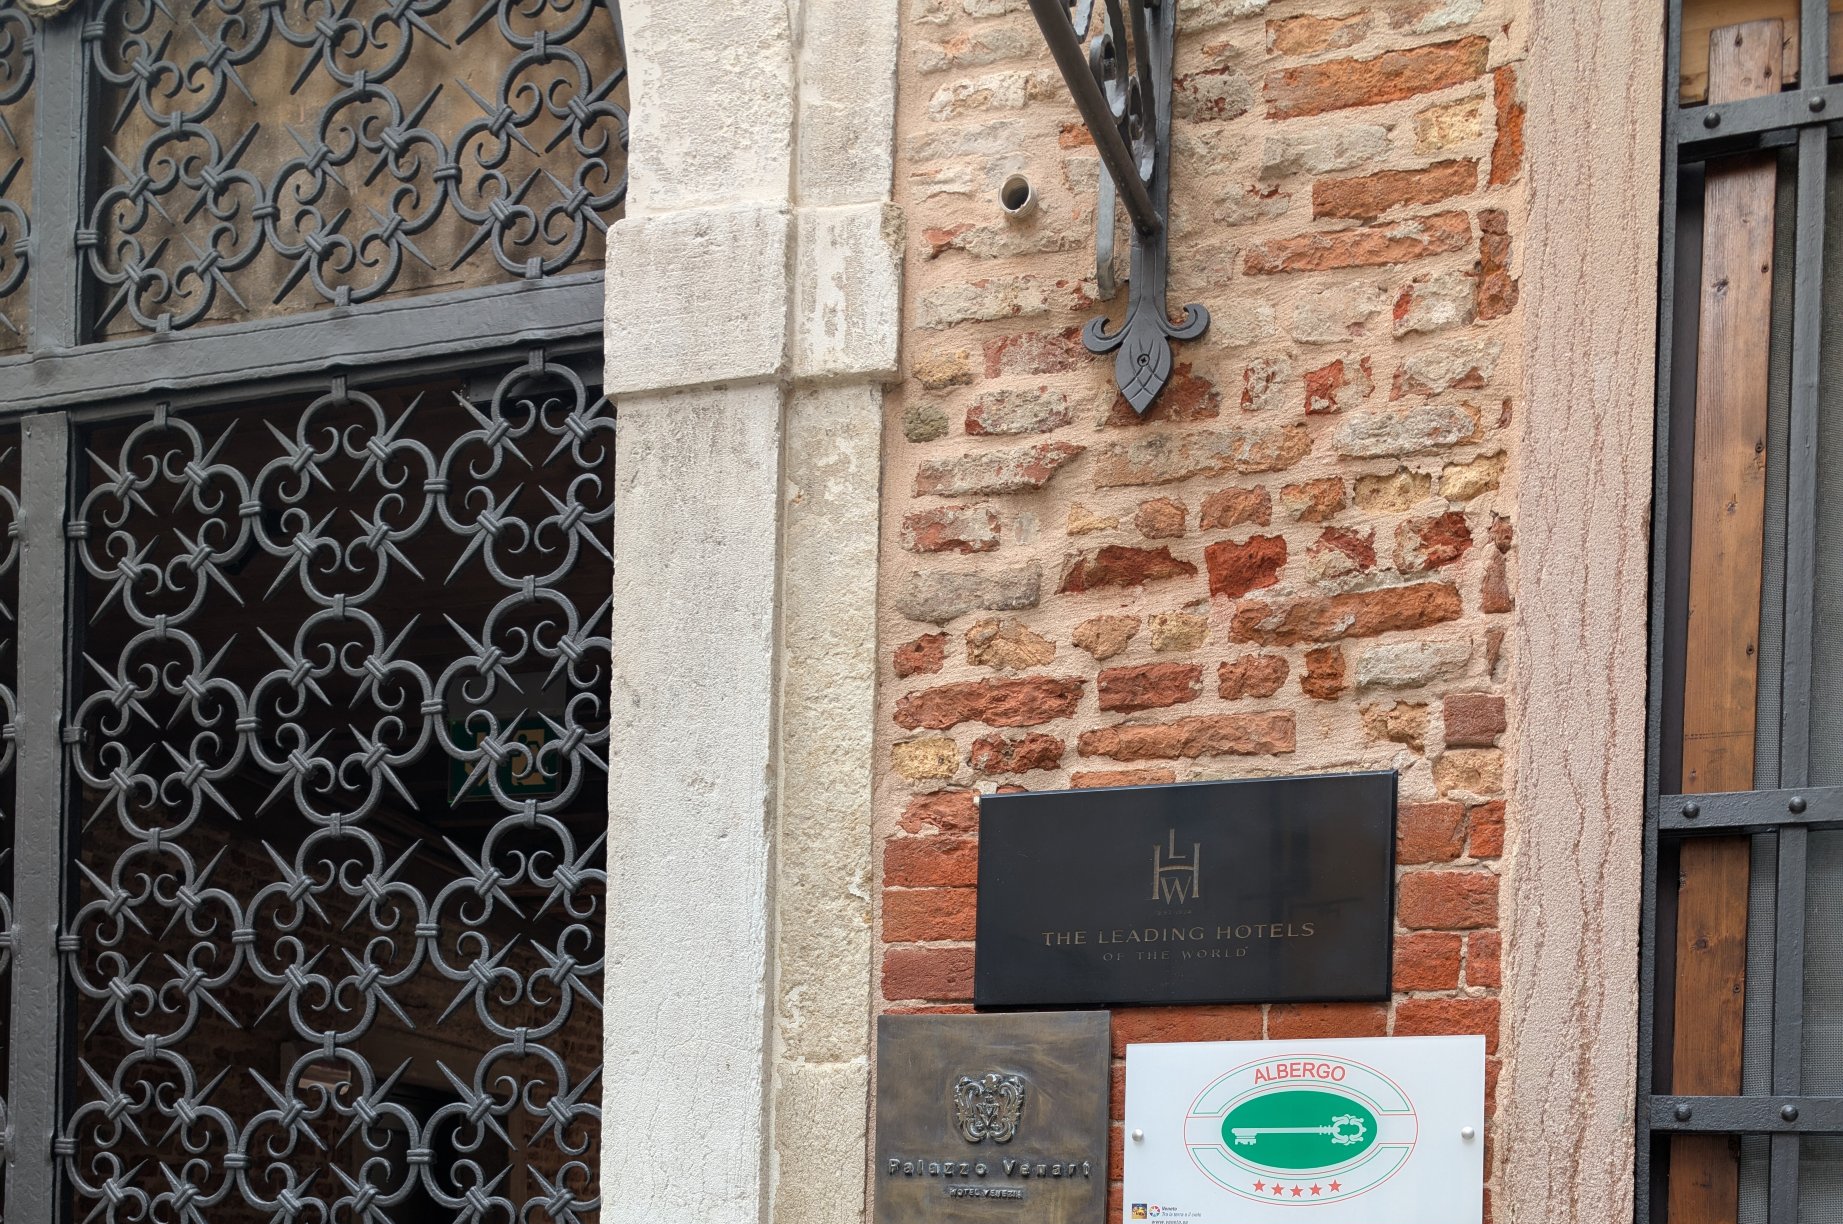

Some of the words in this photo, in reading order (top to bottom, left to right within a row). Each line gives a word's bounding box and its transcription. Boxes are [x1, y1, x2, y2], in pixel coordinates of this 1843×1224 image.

[1042, 930, 1087, 946] THE
[1098, 926, 1205, 944] LEADING
[1216, 922, 1315, 940] HOTELS
[1103, 952, 1125, 961] OF
[1136, 950, 1170, 960] THE
[1182, 948, 1247, 960] WORLD
[1253, 1062, 1346, 1084] ALBERGO
[888, 1158, 988, 1177] Palazzo
[1003, 1158, 1092, 1178] Venart
[949, 1188, 980, 1197] HOTEL
